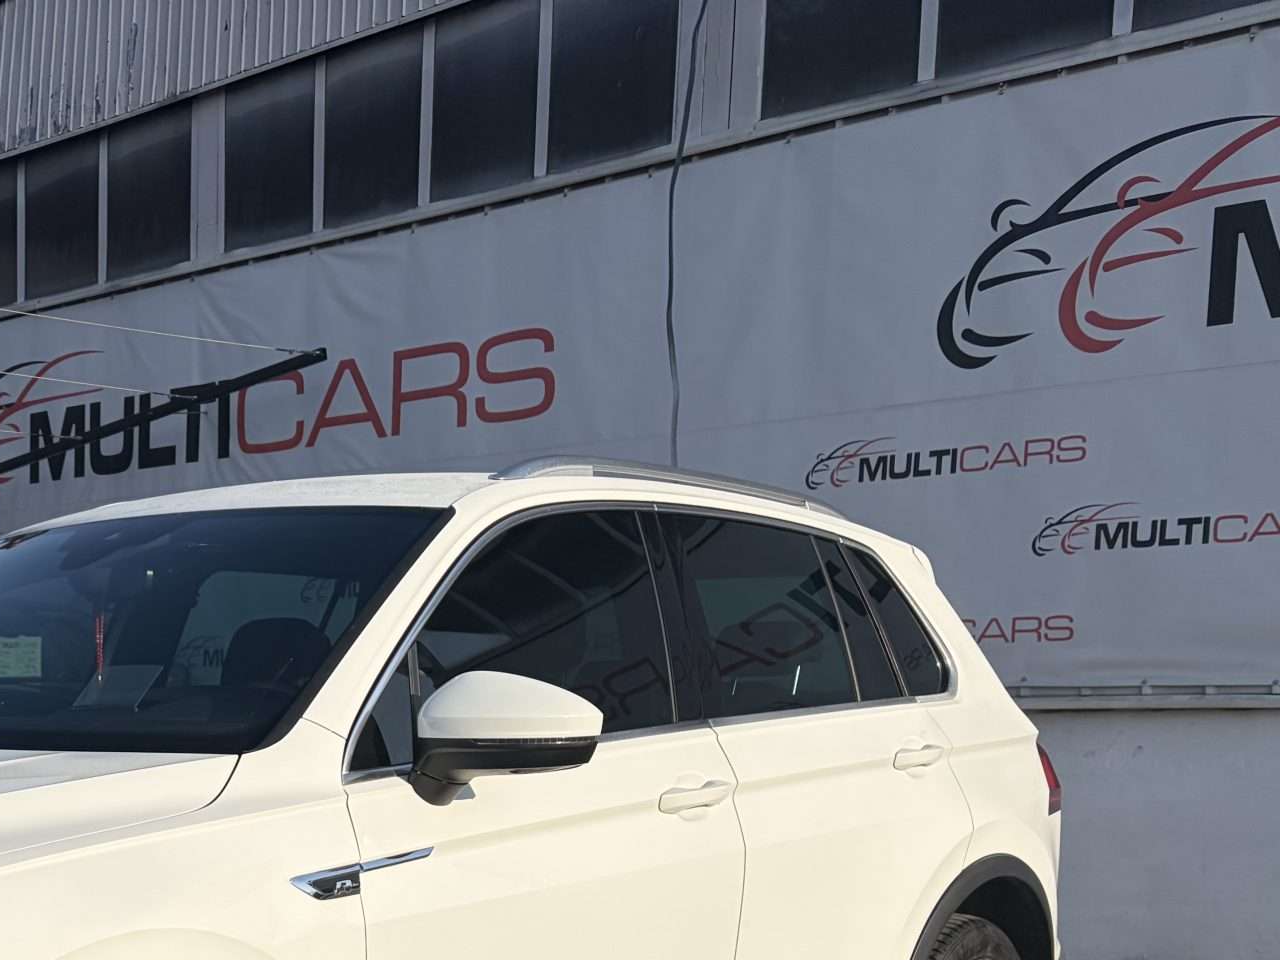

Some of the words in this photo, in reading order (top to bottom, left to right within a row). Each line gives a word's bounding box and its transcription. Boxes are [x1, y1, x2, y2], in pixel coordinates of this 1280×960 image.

[29, 327, 555, 485] MULTICARS
[858, 435, 1087, 483] MULTICARS
[961, 614, 1074, 643] ARS
